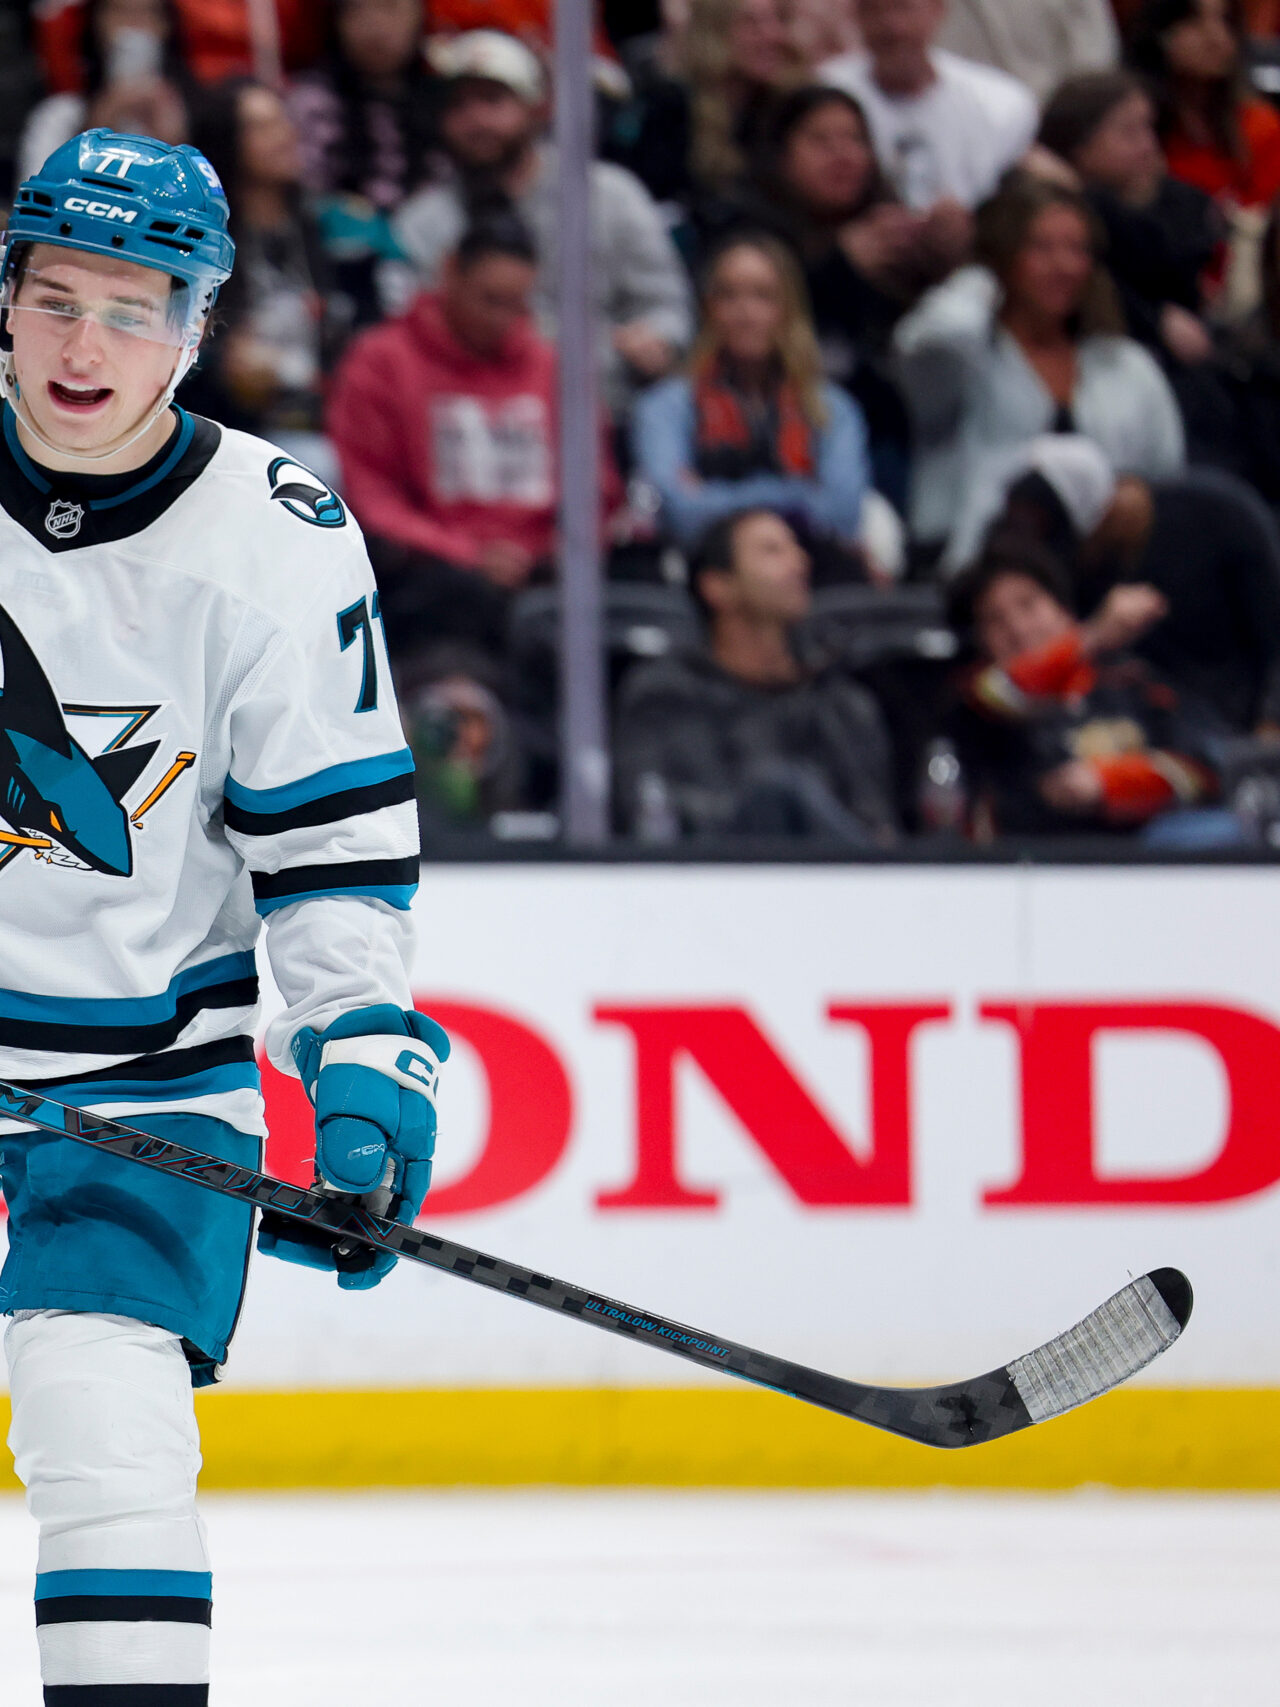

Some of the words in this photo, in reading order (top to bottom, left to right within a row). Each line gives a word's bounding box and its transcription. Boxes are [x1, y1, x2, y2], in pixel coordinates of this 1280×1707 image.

[94, 149, 139, 179] 71
[63, 197, 138, 224] CCM
[52, 512, 76, 528] NHL
[394, 1049, 438, 1092] C
[261, 992, 1280, 1216] OND
[347, 1143, 385, 1160] CCM
[583, 1299, 658, 1332] ULTRALOW
[656, 1326, 730, 1358] KICKPOINT
